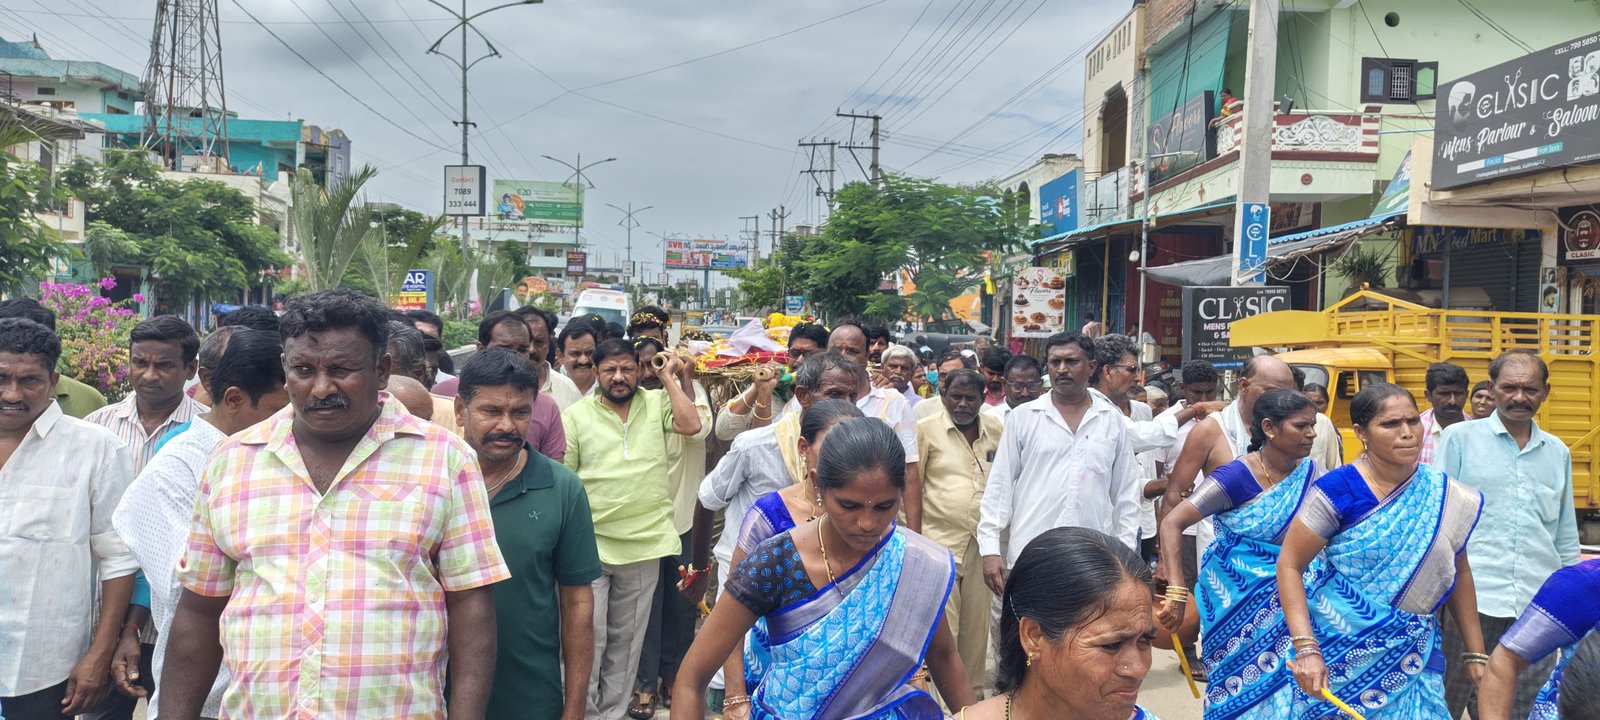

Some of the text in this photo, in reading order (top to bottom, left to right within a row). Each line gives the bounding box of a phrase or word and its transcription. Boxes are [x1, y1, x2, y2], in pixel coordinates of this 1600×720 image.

[1570, 40, 1581, 51] 799
[1582, 36, 1598, 47] 5850
[1438, 135, 1474, 162] Mens
[1475, 122, 1526, 155] Parlour
[1543, 103, 1600, 140] Saloon
[448, 200, 462, 208] 333
[1471, 228, 1497, 245] Mart
[1570, 251, 1595, 259] CLASIC
[1203, 322, 1226, 331] MENS
